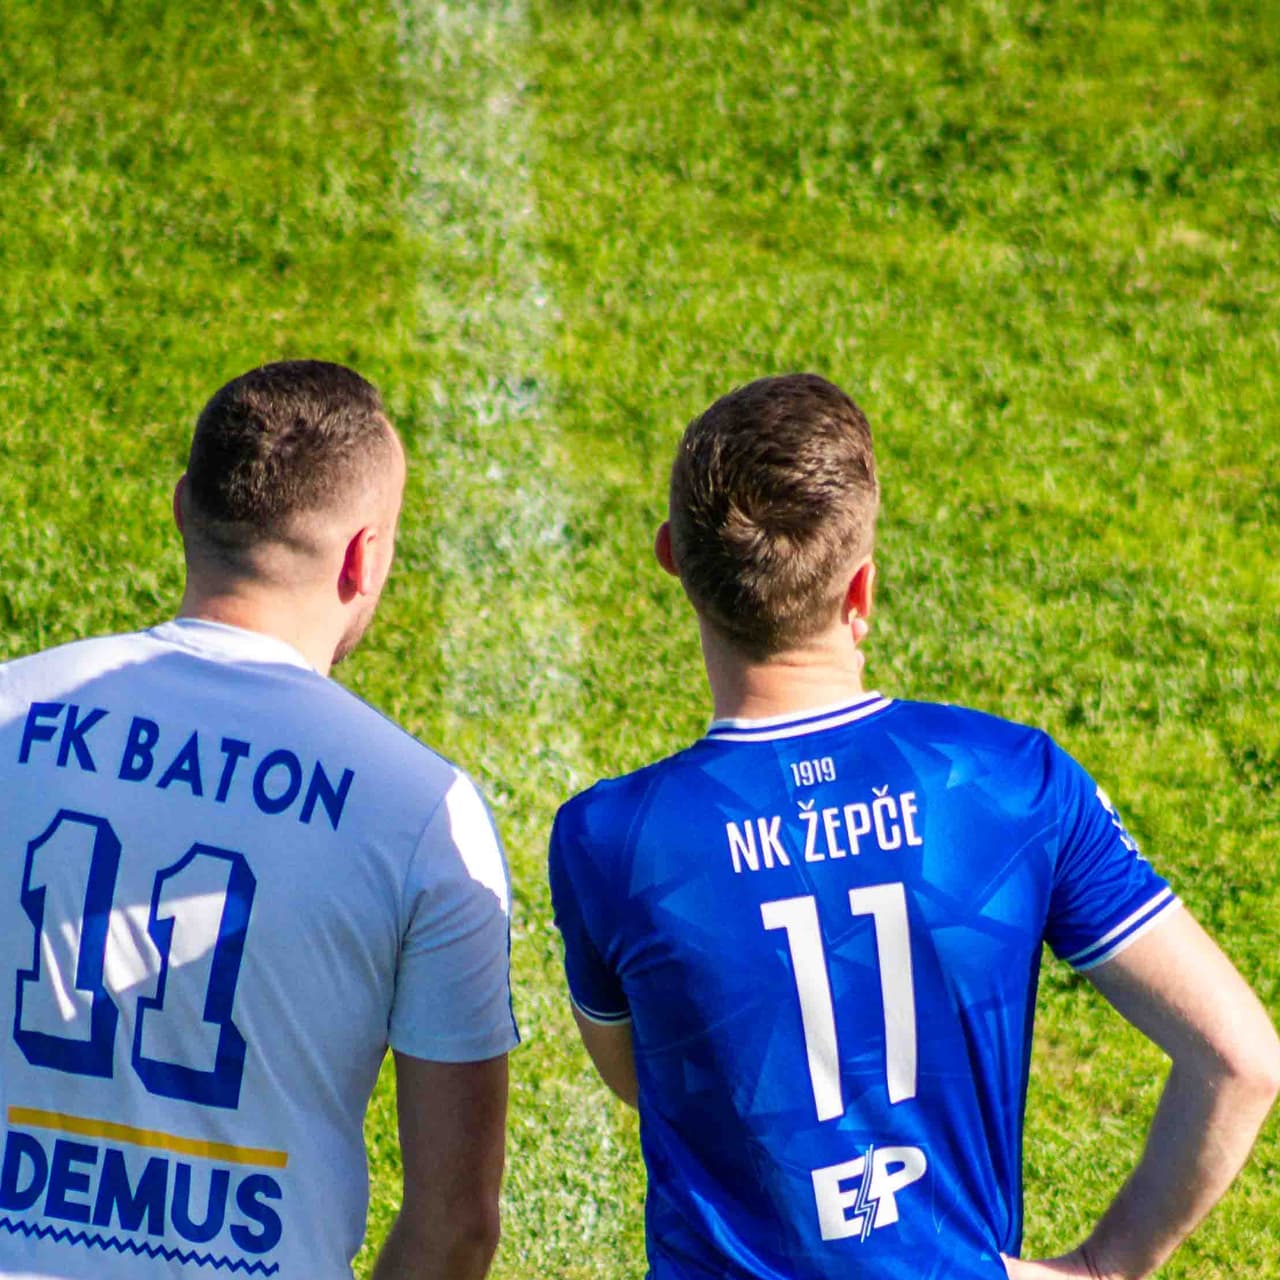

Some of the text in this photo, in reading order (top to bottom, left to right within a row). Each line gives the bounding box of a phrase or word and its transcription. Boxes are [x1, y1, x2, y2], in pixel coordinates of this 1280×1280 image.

[18, 702, 354, 831] FK BATON
[790, 756, 836, 787] 1919
[726, 784, 923, 873] NK ŽEPČE
[13, 808, 257, 1110] 11
[760, 881, 916, 1121] 11
[811, 1144, 927, 1243] EP
